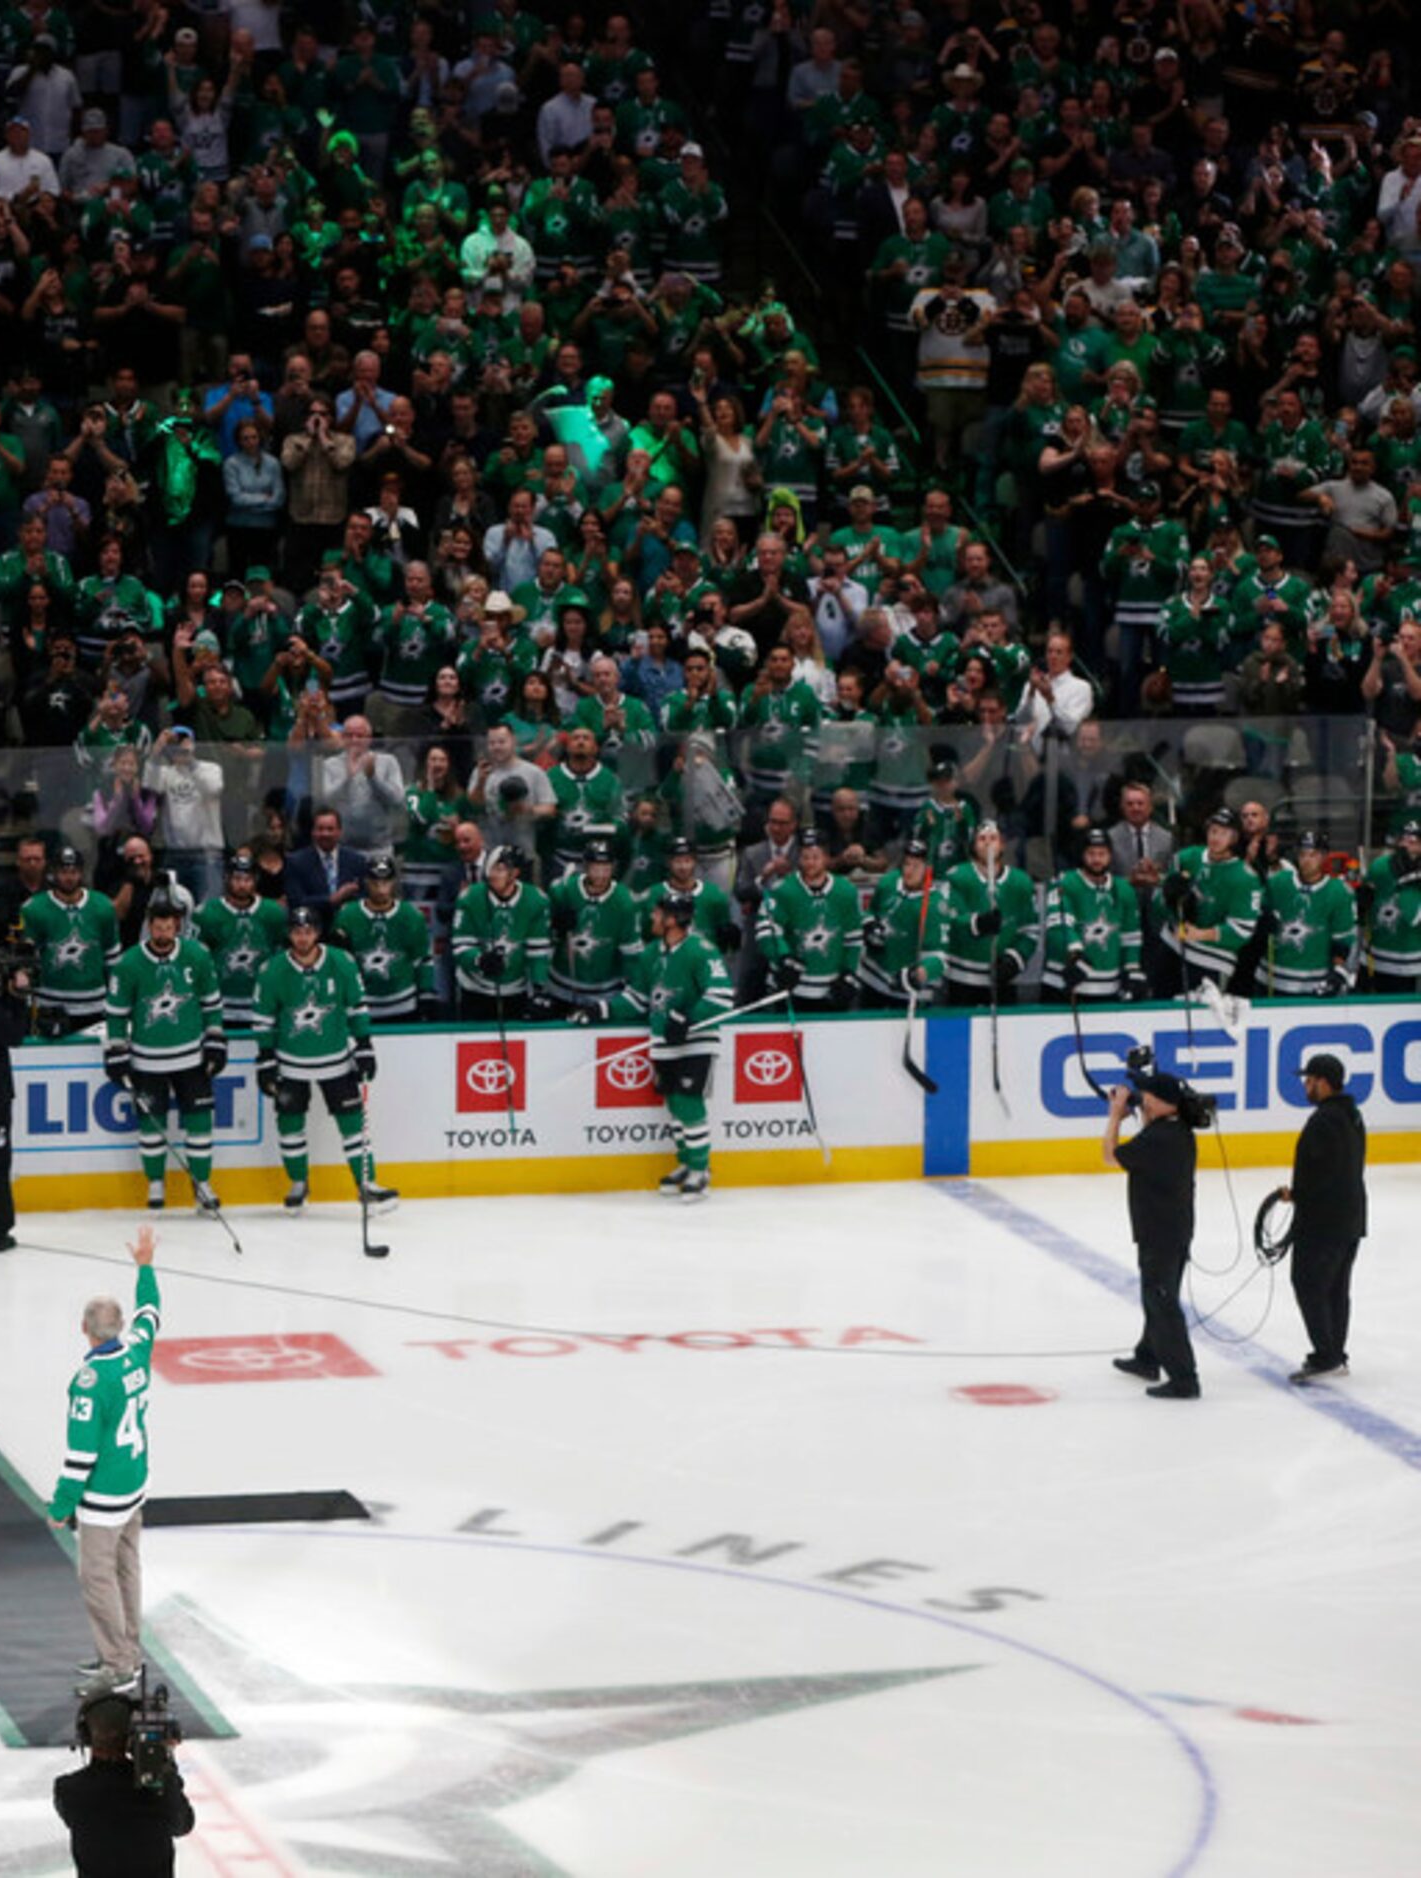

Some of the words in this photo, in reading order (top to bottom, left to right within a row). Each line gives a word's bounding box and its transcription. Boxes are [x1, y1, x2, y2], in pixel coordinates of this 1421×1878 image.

[27, 1076, 247, 1135] LIGT
[445, 1128, 537, 1148] TOYOTA
[585, 1122, 674, 1144] TOYOTA
[722, 1119, 811, 1139] TOYOTA
[403, 1325, 928, 1360] TOYOTA
